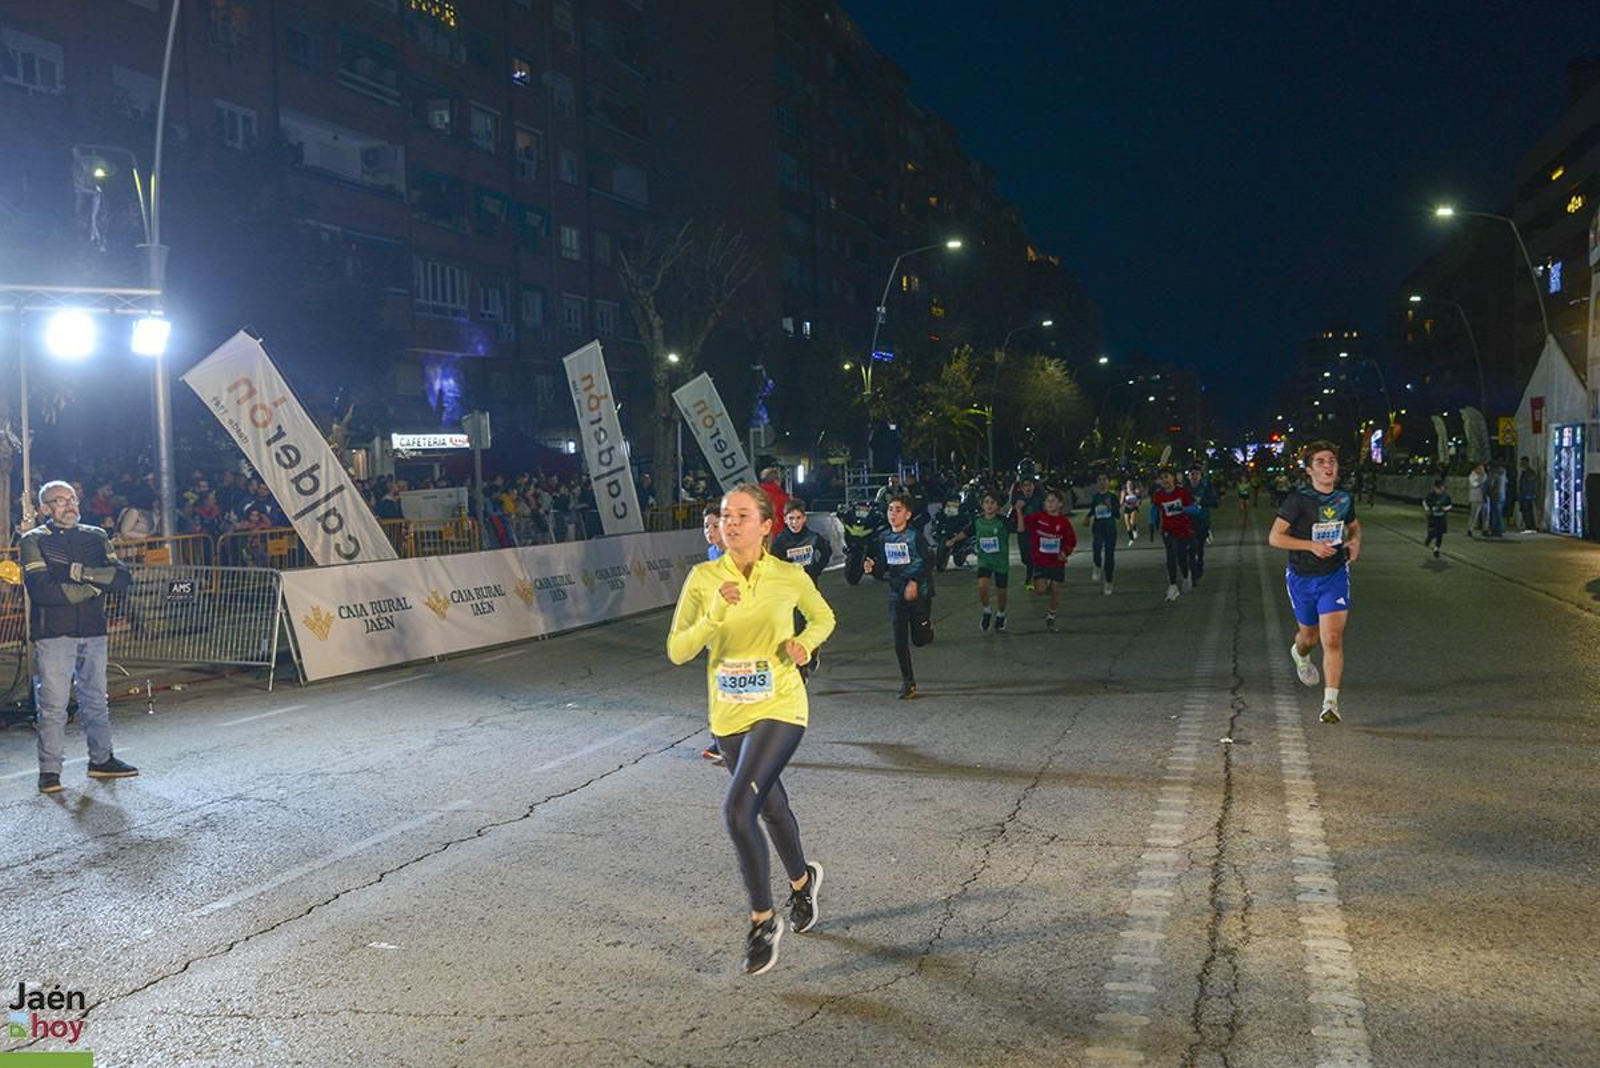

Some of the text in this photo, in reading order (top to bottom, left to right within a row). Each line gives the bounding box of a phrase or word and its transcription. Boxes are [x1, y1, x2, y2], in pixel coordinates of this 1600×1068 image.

[172, 583, 192, 594] AMS
[450, 584, 506, 604] CAJA RURAL
[338, 597, 412, 619] CAJA RURAL
